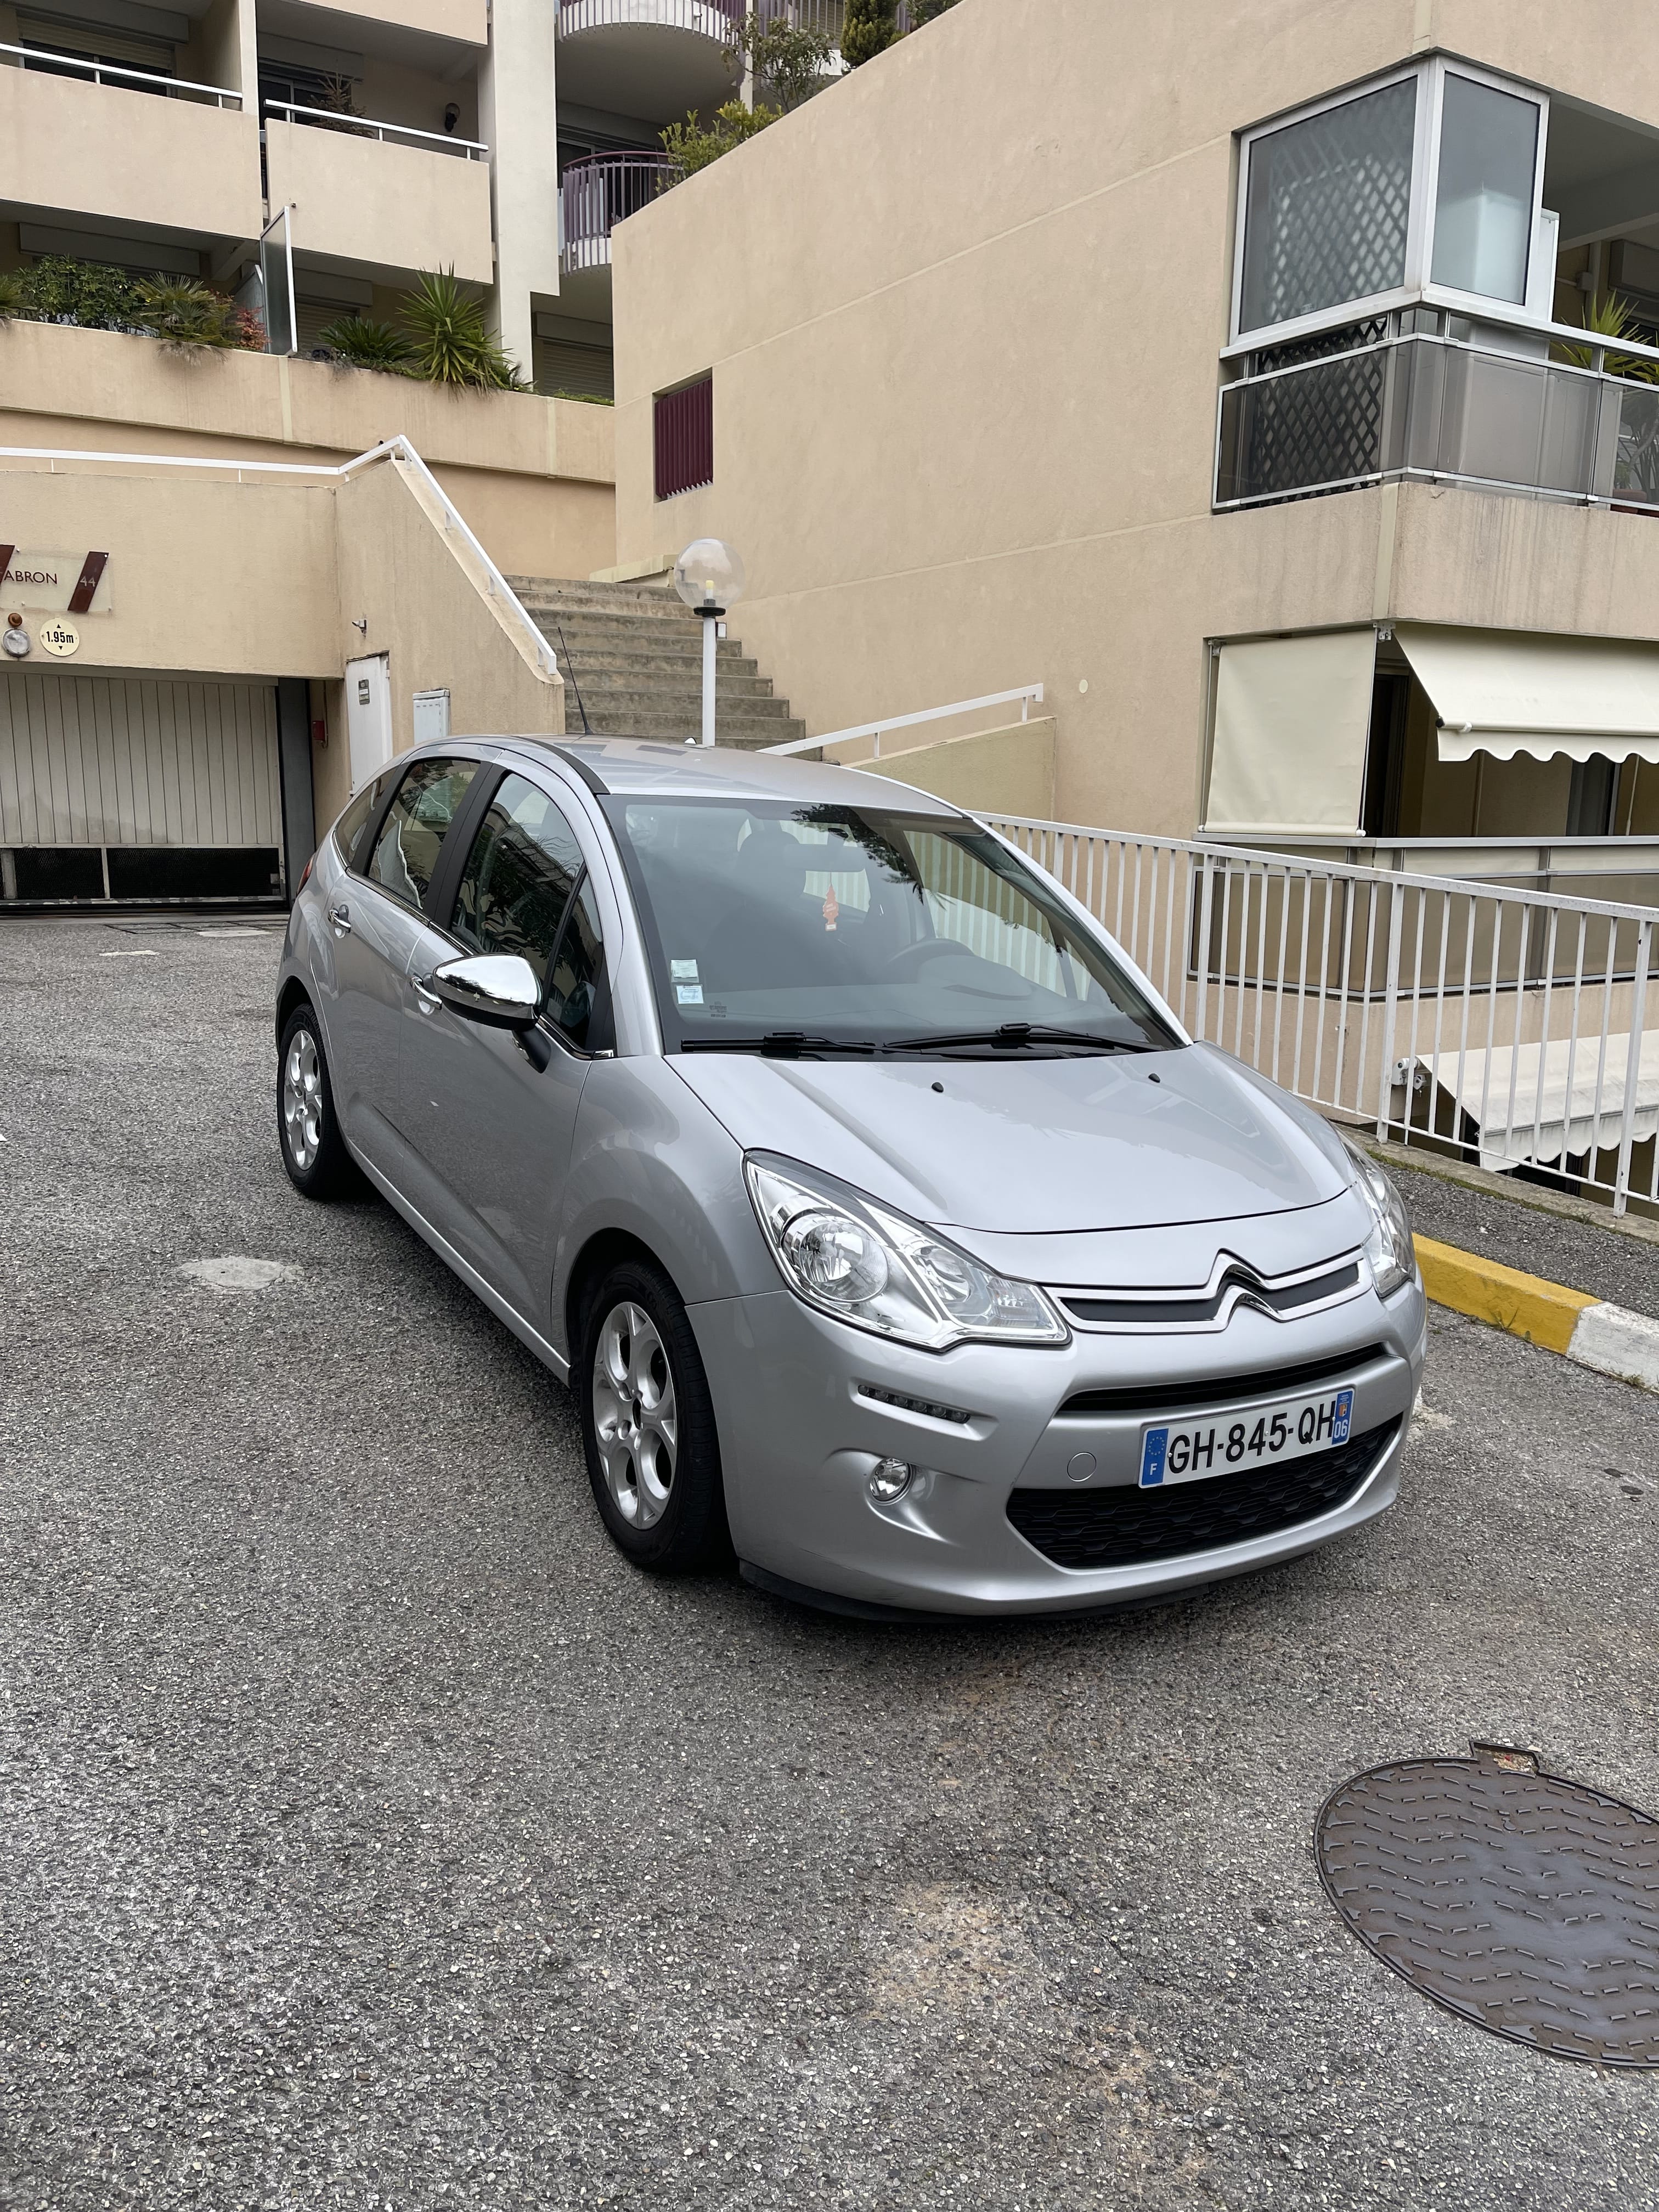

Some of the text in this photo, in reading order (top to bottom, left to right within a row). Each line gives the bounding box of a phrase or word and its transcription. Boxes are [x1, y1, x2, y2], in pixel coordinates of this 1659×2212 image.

[80, 575, 95, 588] 44
[46, 631, 74, 644] 1.95m
[1334, 1419, 1348, 1439] 06
[1168, 1400, 1336, 1474] GH-845-QH
[1150, 1463, 1158, 1476] F
